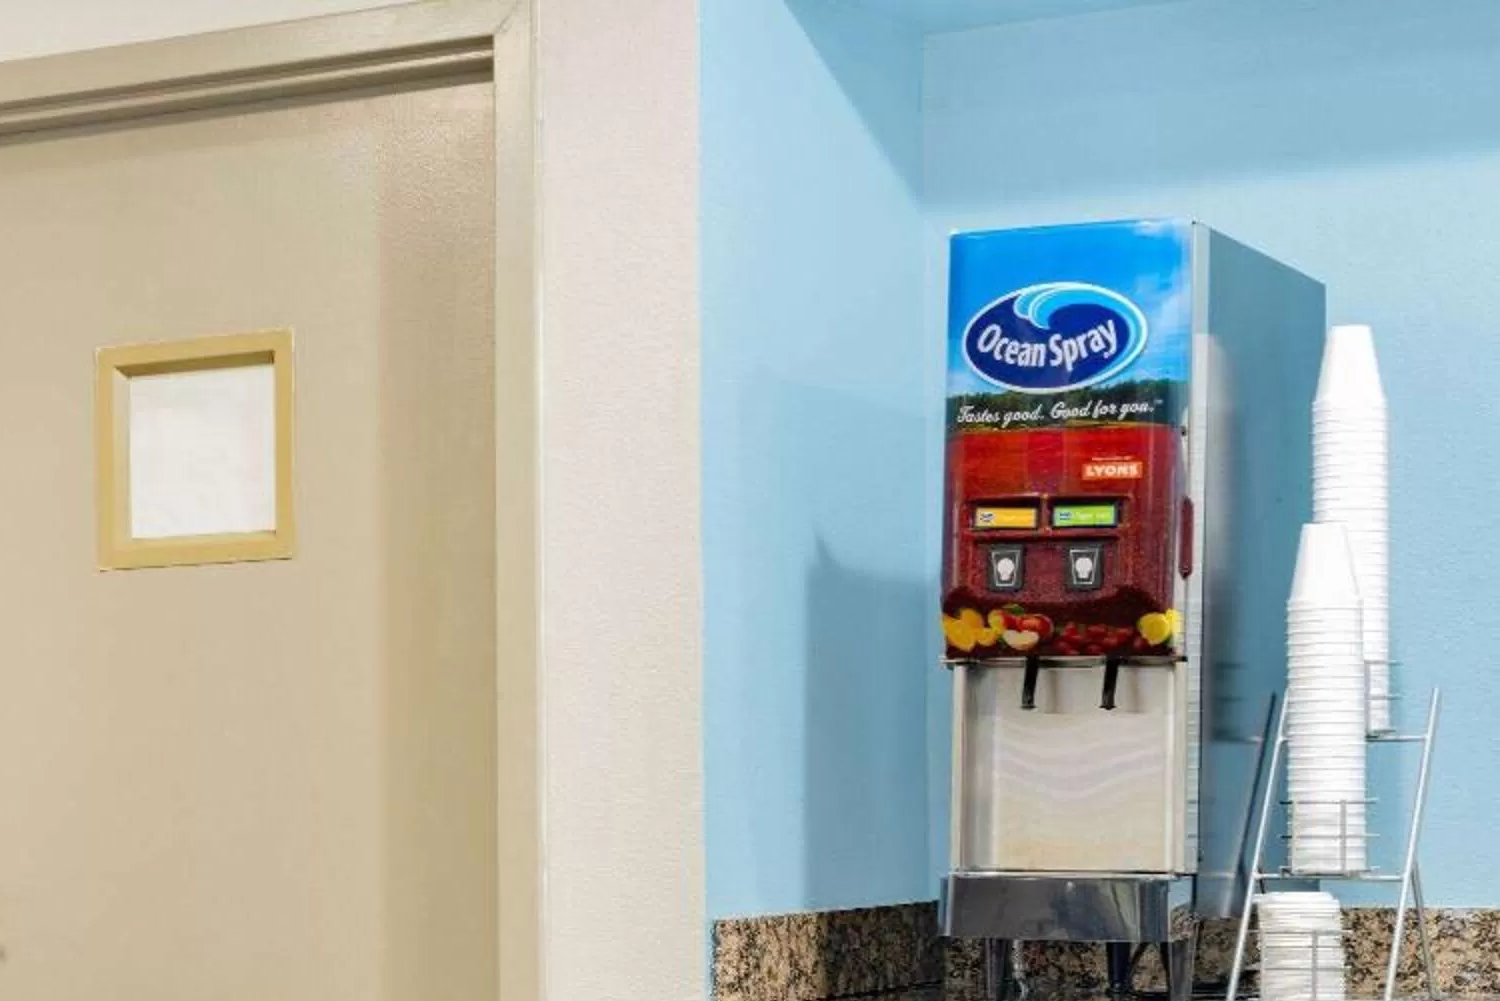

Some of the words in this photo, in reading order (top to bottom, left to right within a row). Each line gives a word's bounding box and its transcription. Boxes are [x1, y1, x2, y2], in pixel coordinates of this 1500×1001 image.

[977, 323, 1046, 367] Ocean
[1049, 319, 1118, 372] Spray
[957, 405, 1001, 423] Tastes
[1051, 400, 1090, 419] Good
[1092, 399, 1117, 419] for
[1085, 464, 1138, 477] LYONS
